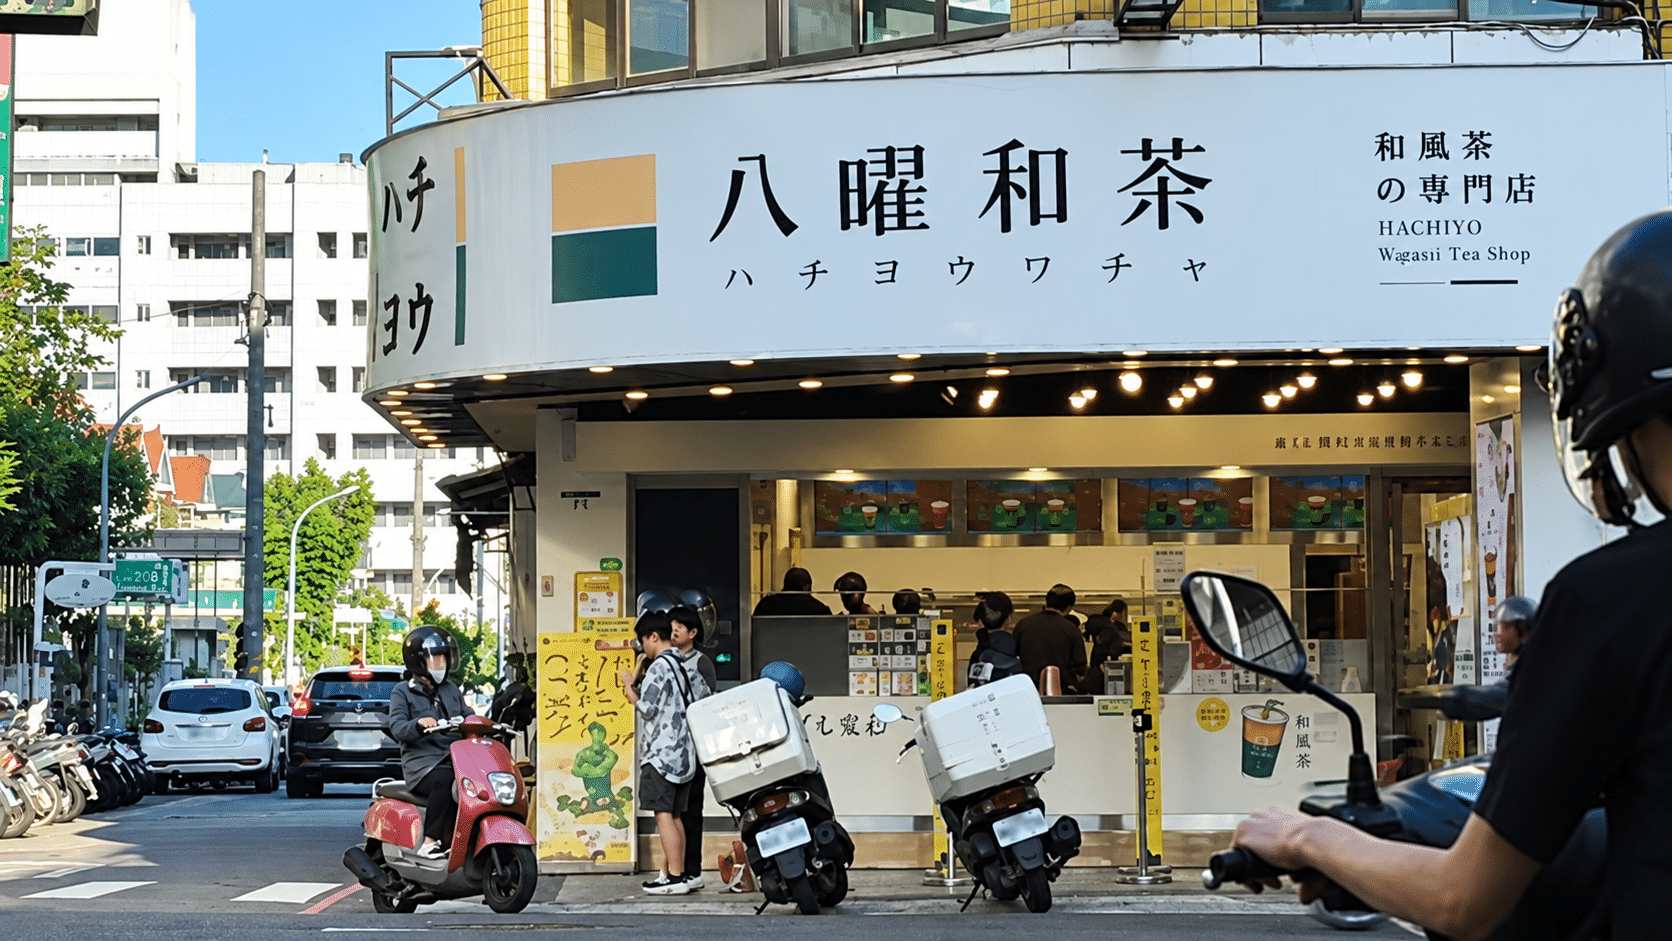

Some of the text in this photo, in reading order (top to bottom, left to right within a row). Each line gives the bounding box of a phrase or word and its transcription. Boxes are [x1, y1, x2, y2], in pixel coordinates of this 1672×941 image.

[1374, 130, 1493, 162] 和風茶
[709, 137, 1213, 243] 八曜和茶
[1377, 173, 1536, 205] の専門店
[1378, 219, 1482, 236] HACHIYO
[1449, 246, 1480, 261] Tea
[1487, 245, 1531, 265] Shop
[134, 571, 159, 583] 208
[1294, 714, 1312, 769] 和風茶
